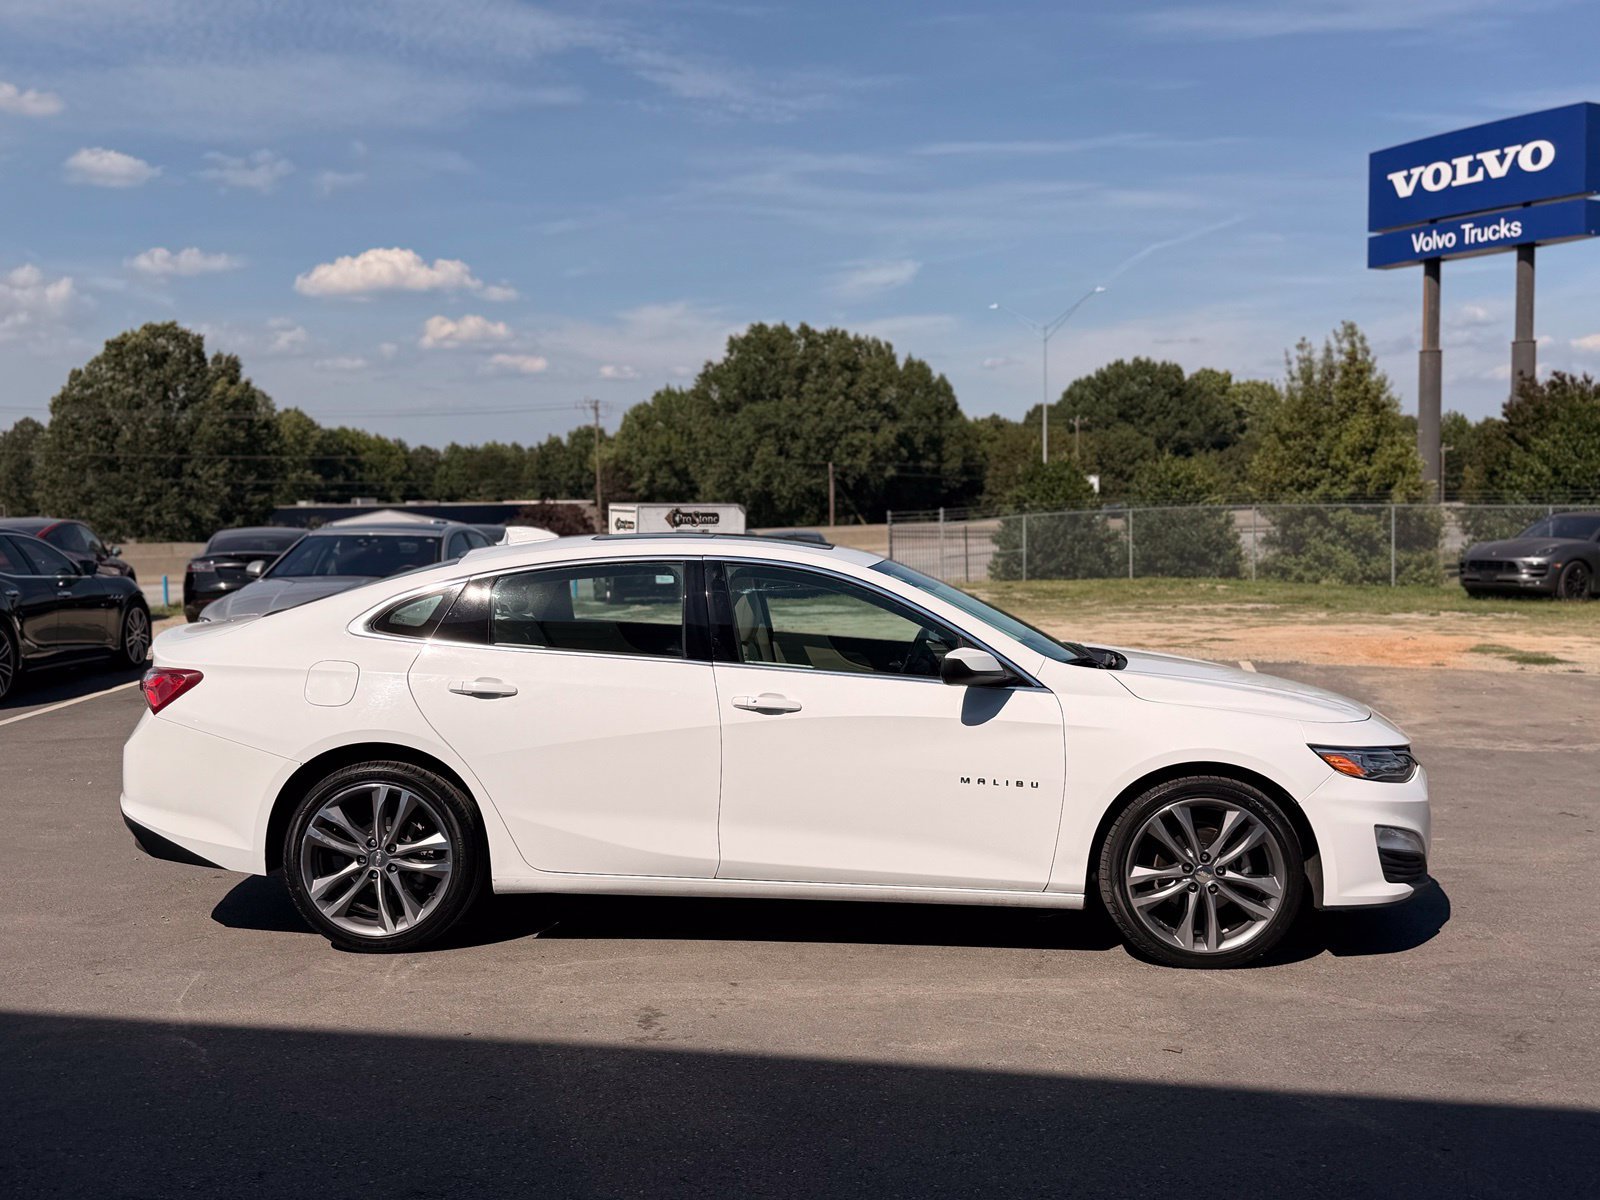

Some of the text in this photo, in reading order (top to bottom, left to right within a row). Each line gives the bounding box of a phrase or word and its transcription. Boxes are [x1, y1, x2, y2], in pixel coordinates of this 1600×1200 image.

[1387, 139, 1556, 199] VOLVO
[1411, 217, 1523, 253] Volvo Trucks
[960, 776, 1039, 789] MALIBU
